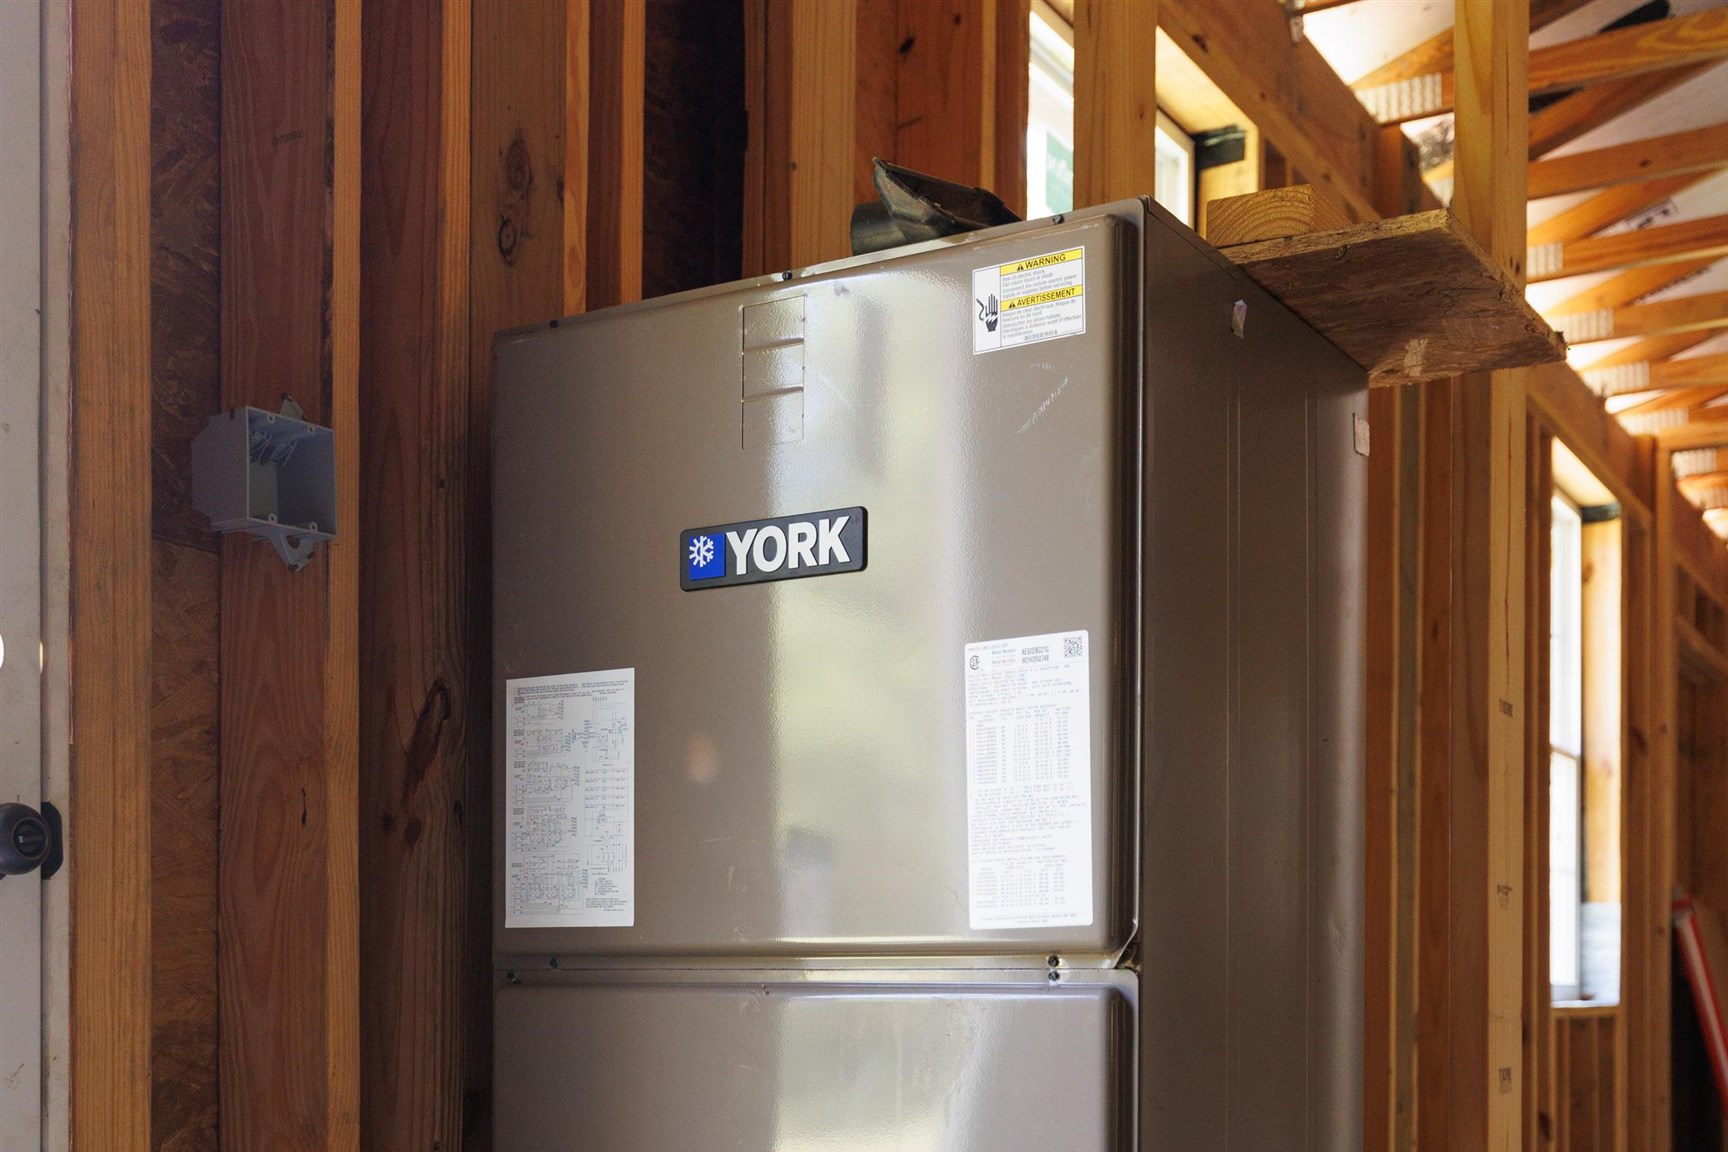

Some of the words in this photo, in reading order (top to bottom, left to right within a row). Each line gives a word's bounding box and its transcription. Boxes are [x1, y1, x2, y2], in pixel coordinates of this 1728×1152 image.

[1025, 254, 1066, 269] WARNING
[1017, 288, 1076, 306] AVERTISSEMENT
[726, 516, 851, 576] YORK
